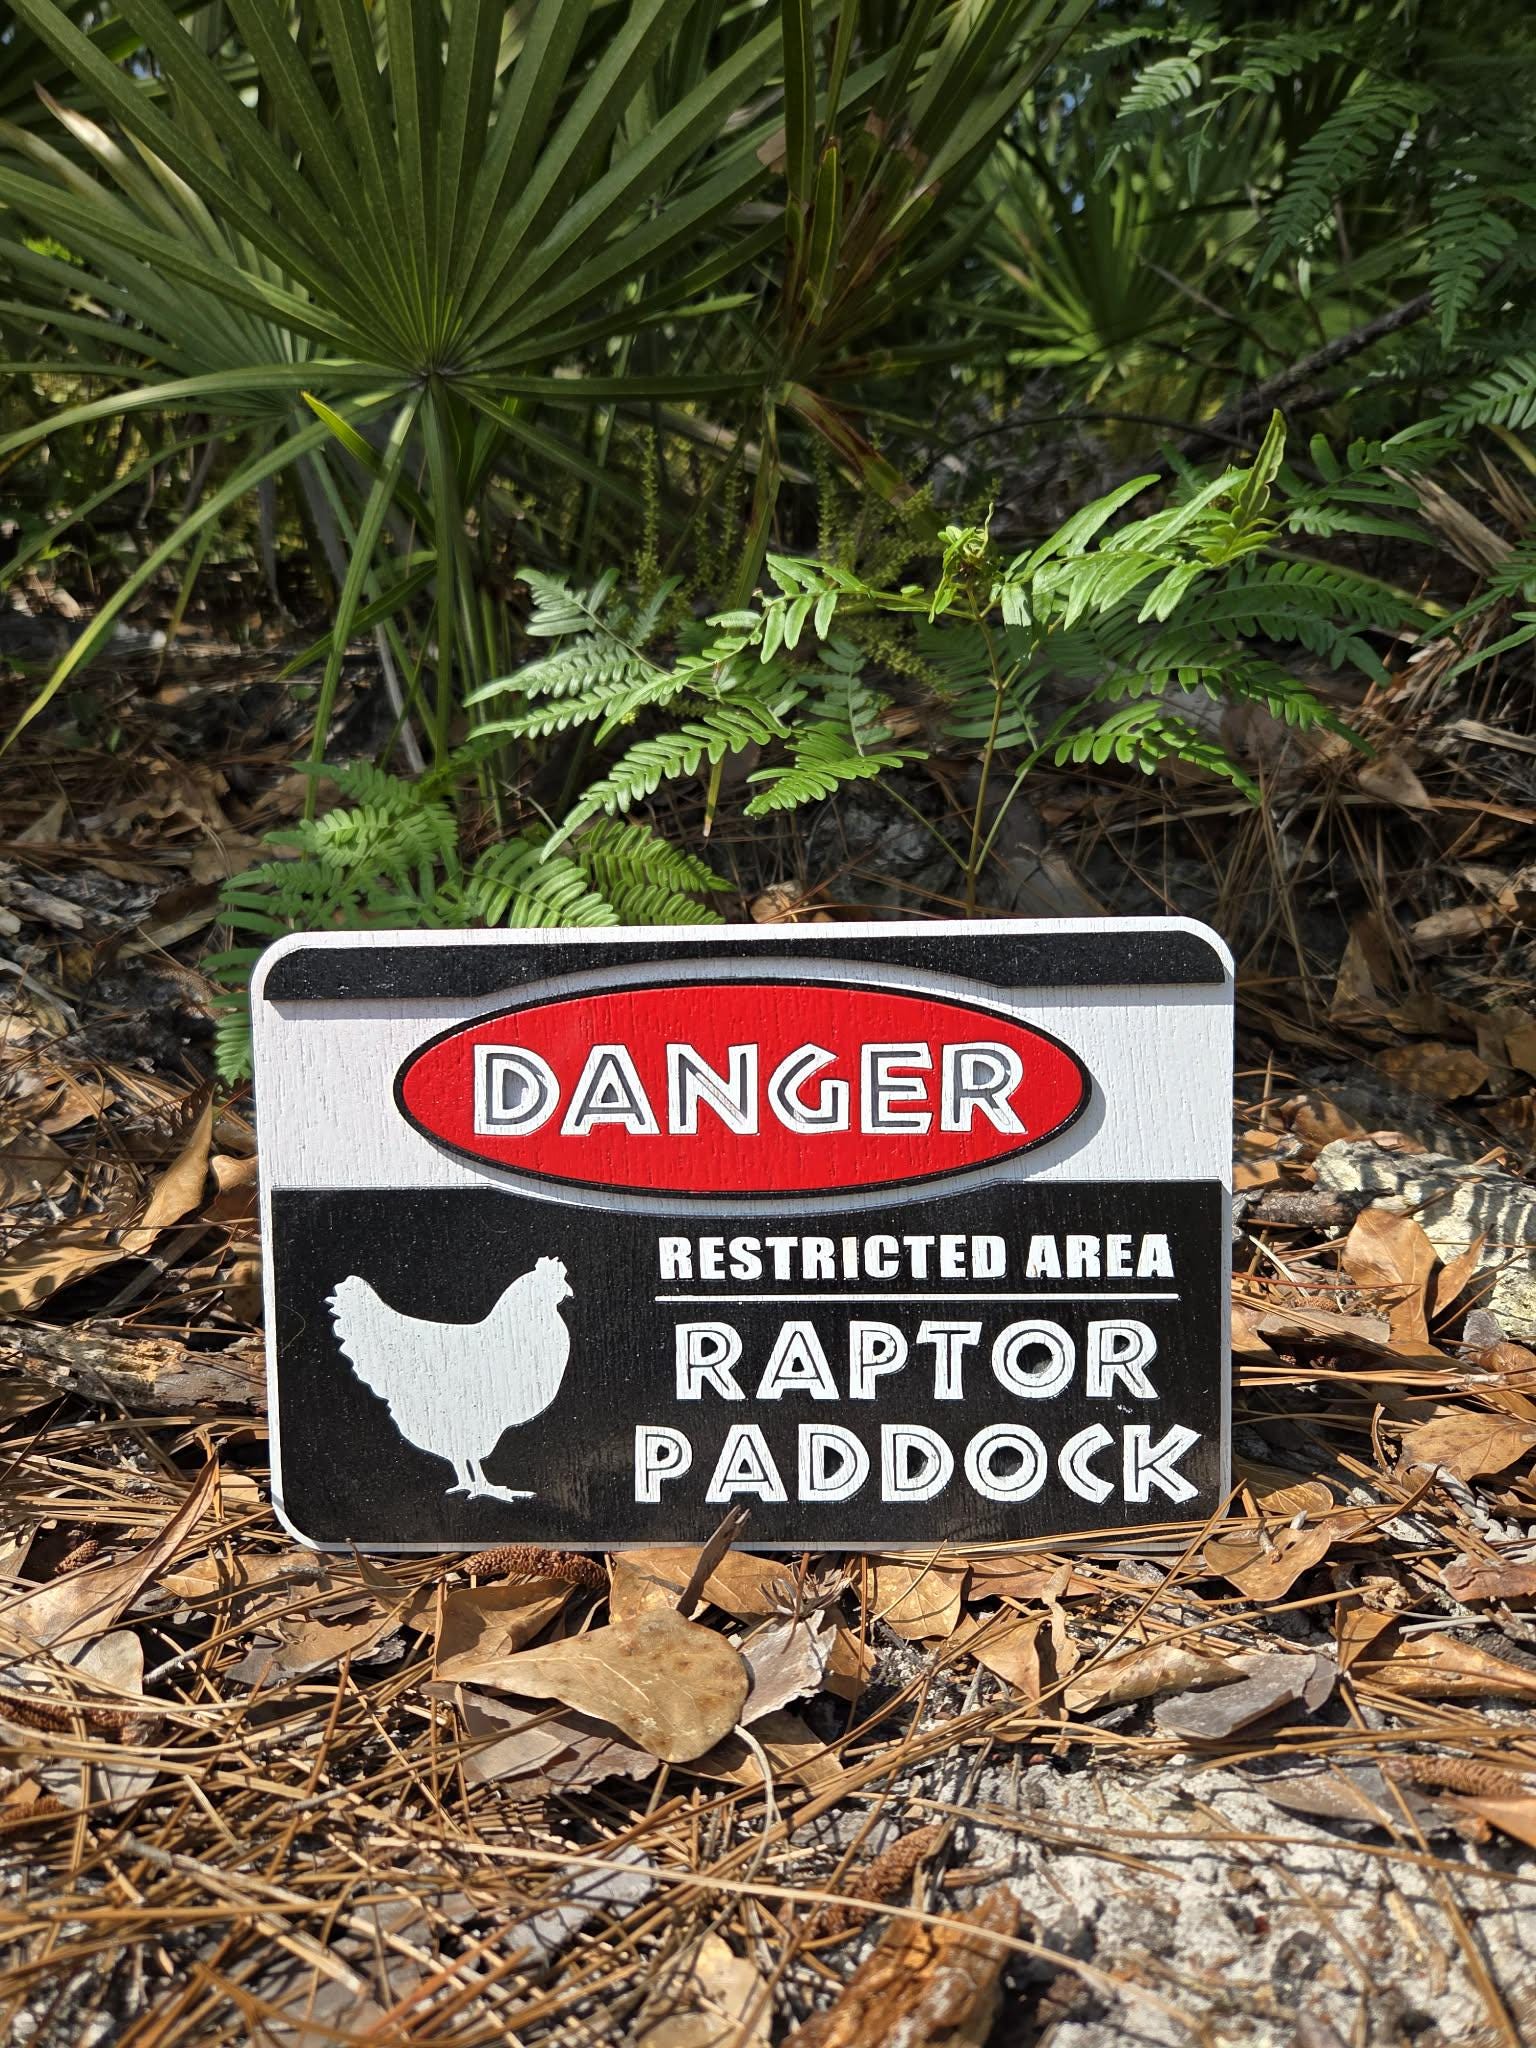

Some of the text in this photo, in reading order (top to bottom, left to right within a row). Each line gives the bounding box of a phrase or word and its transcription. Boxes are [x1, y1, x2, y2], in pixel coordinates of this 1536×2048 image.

[472, 1041, 1029, 1138] DANGER
[657, 1233, 1176, 1281] RESTRICTED AREA
[674, 1319, 1160, 1402] RAPTOR
[633, 1422, 1202, 1505] PADDOCK
